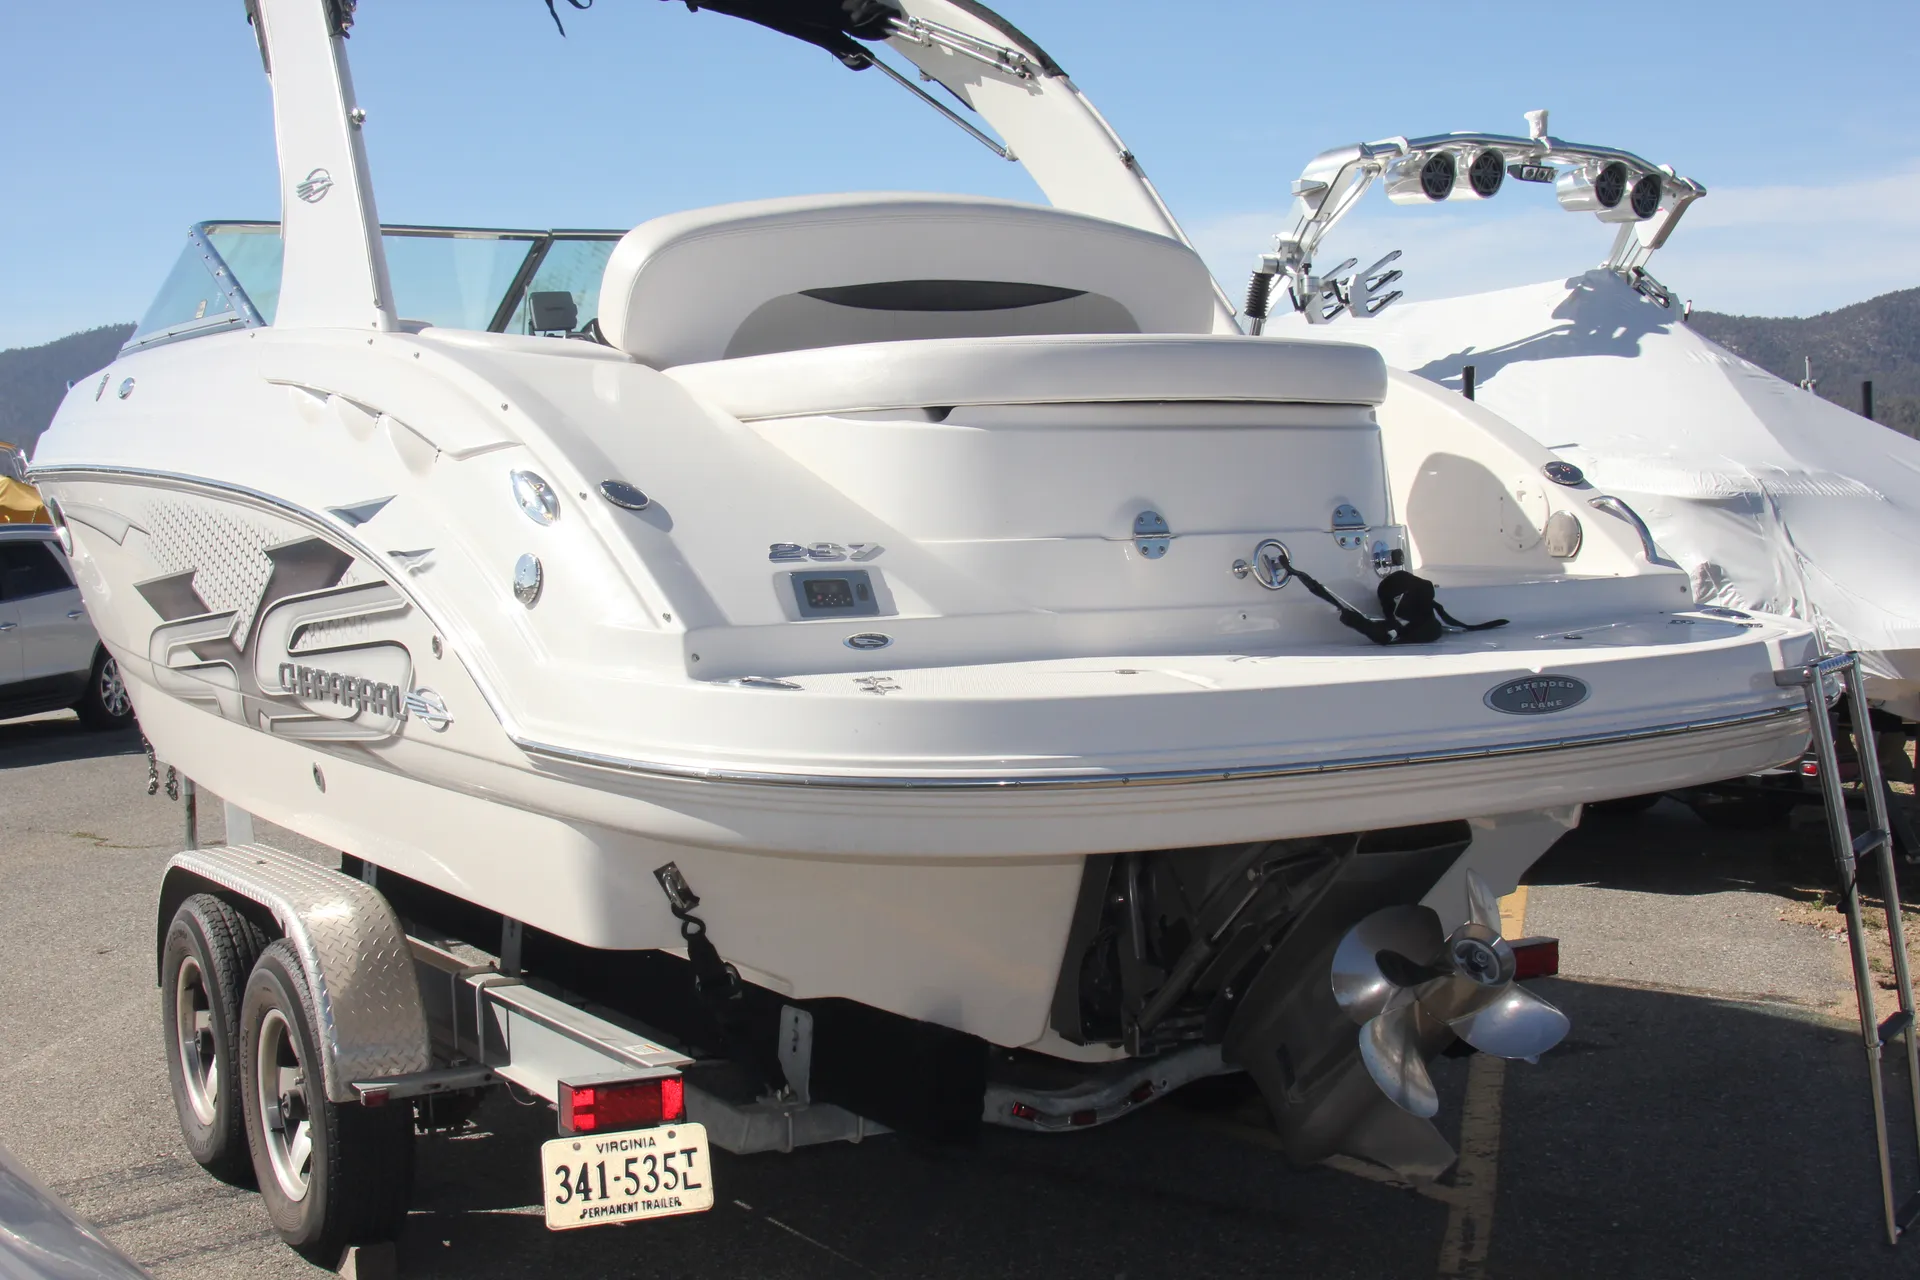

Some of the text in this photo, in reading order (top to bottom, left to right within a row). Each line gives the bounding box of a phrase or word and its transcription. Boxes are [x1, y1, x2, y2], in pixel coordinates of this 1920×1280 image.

[278, 661, 408, 722] CHAPARRAL
[1506, 681, 1574, 694] EXTENDED
[1521, 700, 1563, 709] PLANE
[596, 1137, 656, 1153] VIRGINIA
[581, 1197, 682, 1219] PERMANENT TRAILER
